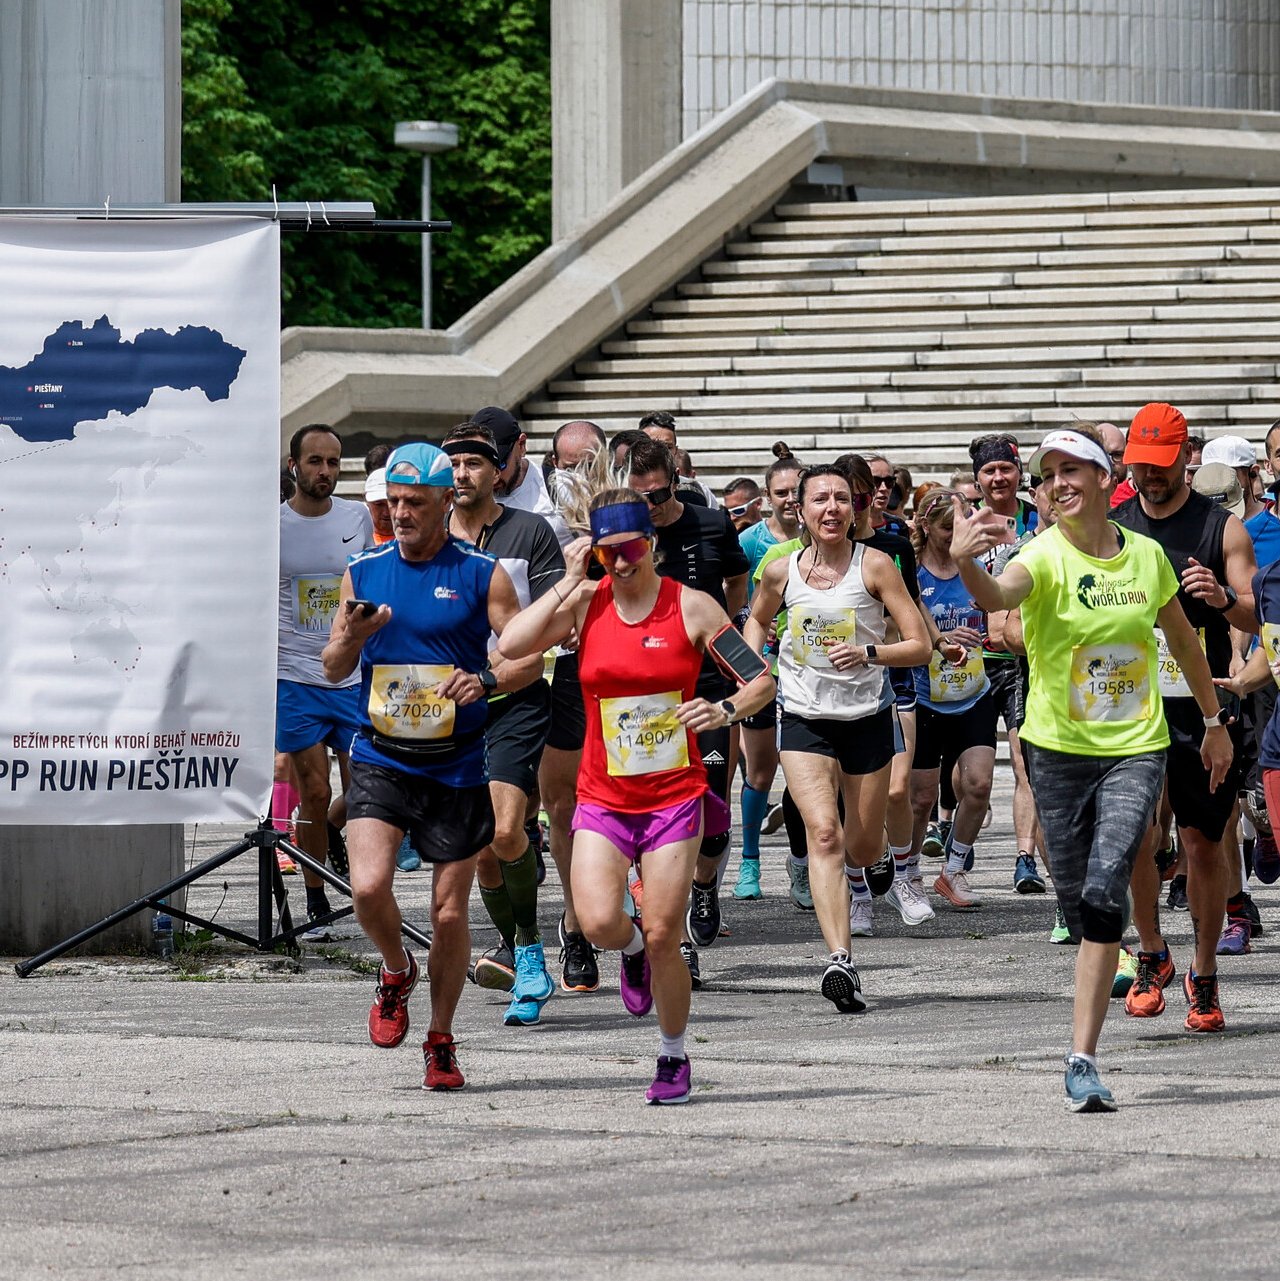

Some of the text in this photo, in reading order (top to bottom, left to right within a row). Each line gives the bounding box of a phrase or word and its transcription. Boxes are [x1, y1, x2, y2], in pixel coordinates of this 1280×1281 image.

[34, 383, 63, 393] PIEŠŤANY
[687, 553, 697, 580] NIKE
[940, 672, 973, 684] 42591
[1089, 679, 1134, 695] 19583
[383, 703, 442, 718] 127020
[13, 730, 241, 749] BEŽÍM PRE TÝCH KTORÍ BEHAŤ NEMÔŽU
[616, 729, 674, 748] 114907
[39, 759, 98, 791] RUN
[107, 749, 240, 791] PIEŠŤANY
